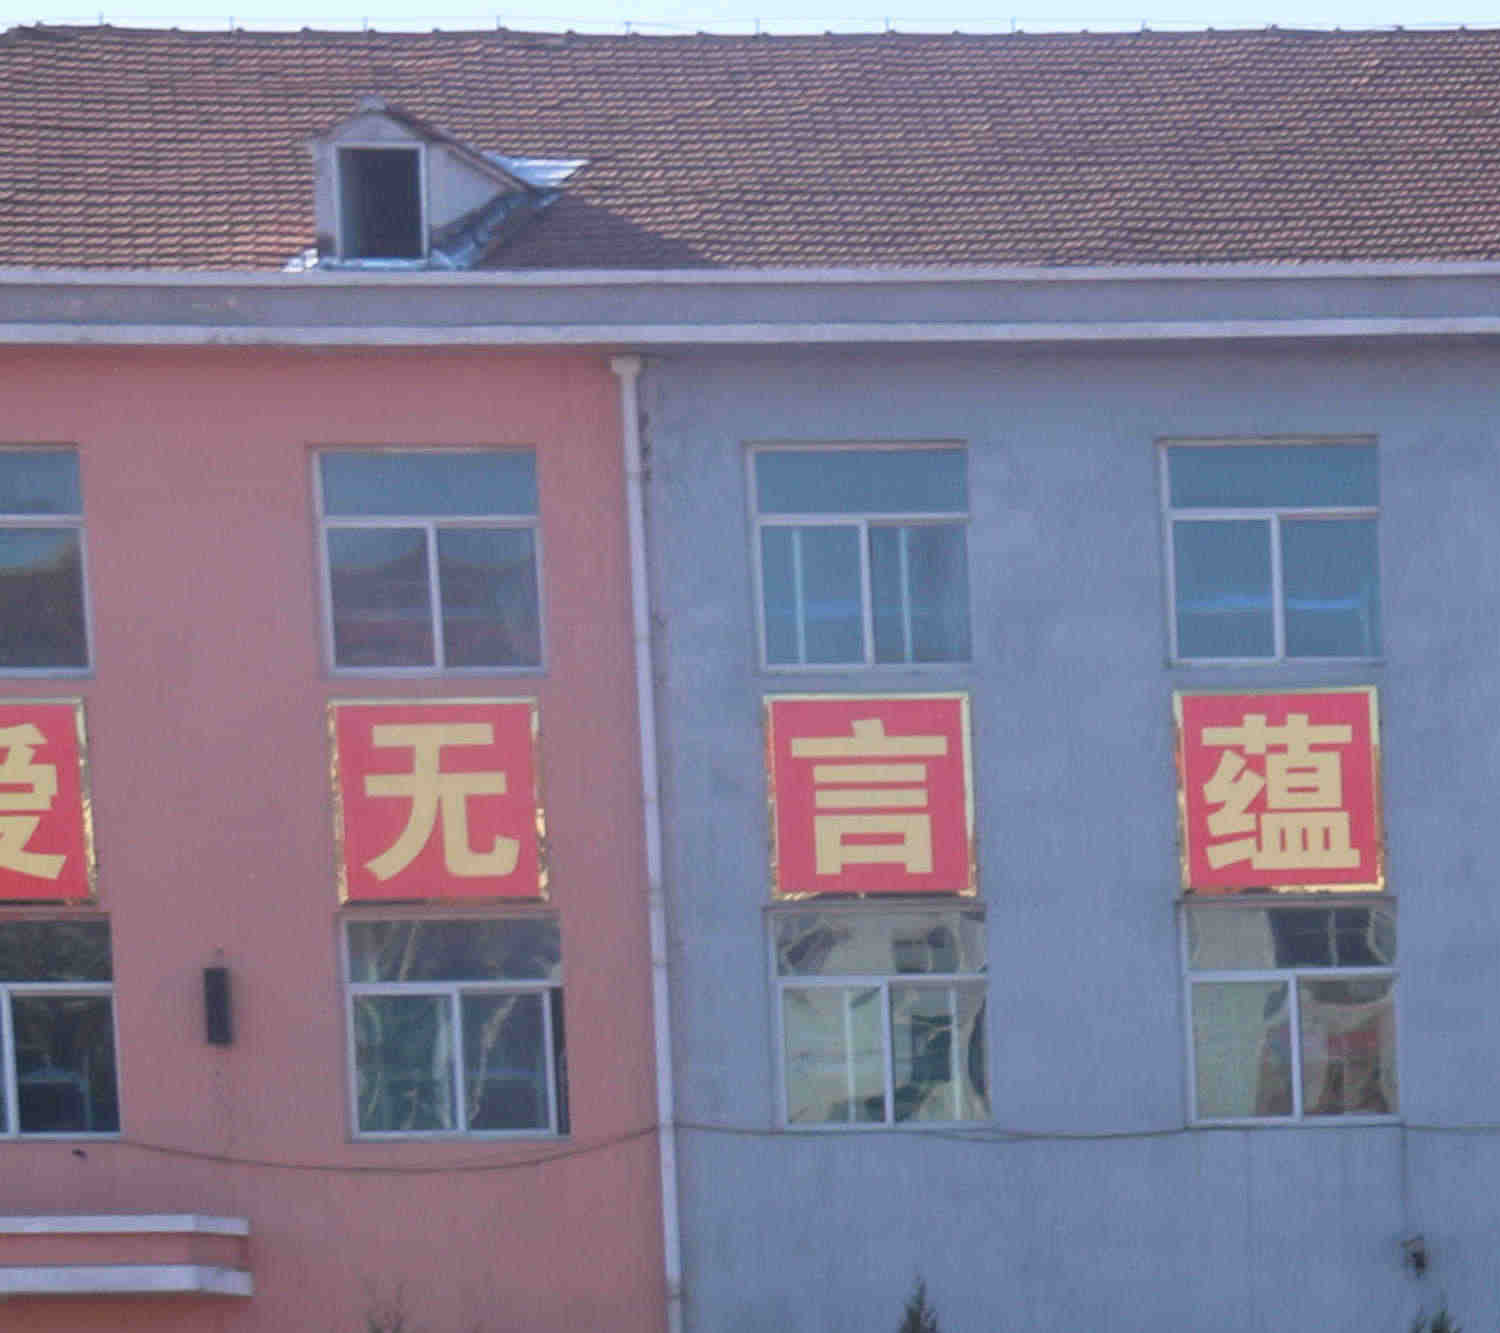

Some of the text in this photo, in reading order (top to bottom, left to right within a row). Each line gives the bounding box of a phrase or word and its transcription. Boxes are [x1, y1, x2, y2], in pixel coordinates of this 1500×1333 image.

[364, 723, 520, 881] 无
[792, 718, 949, 877] 言
[1201, 713, 1361, 871] 蕴
